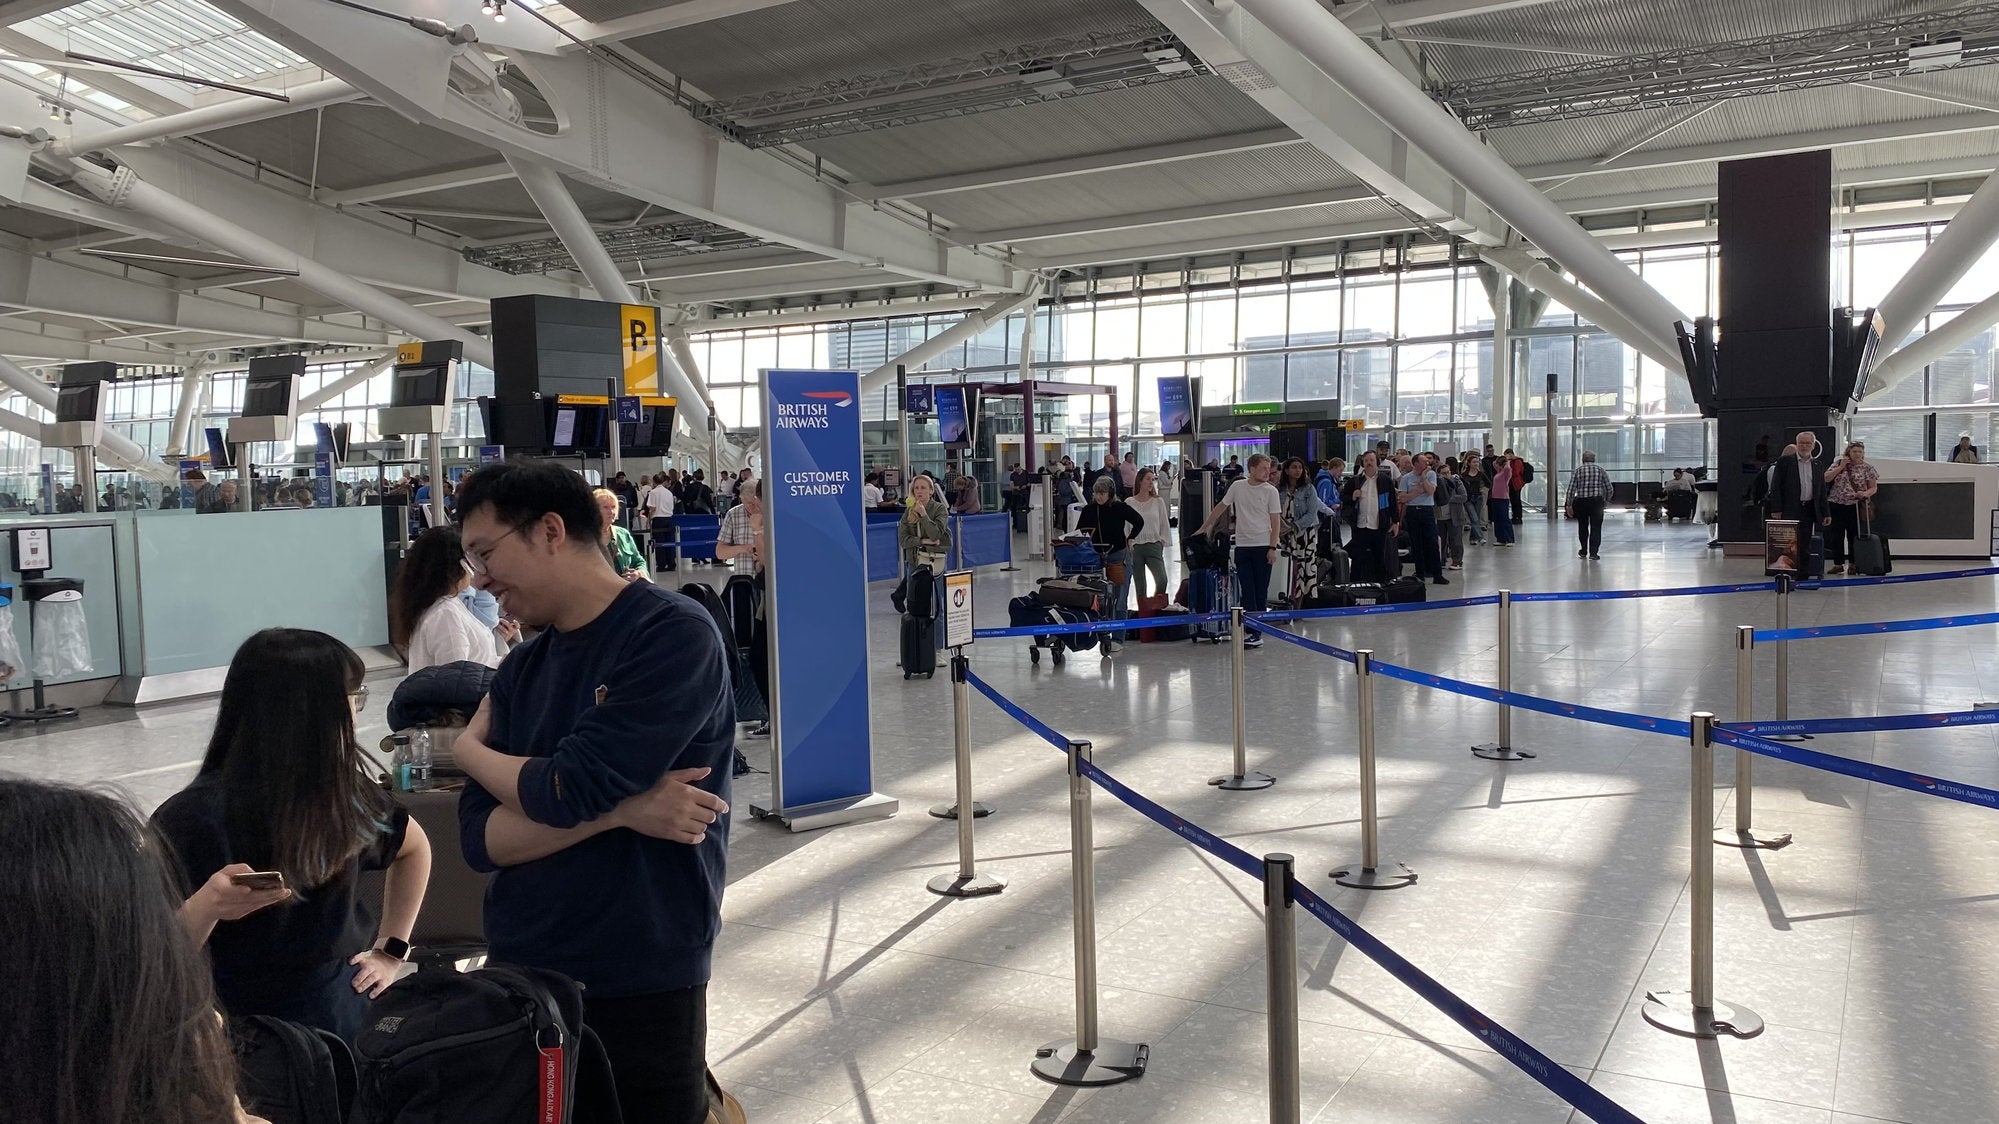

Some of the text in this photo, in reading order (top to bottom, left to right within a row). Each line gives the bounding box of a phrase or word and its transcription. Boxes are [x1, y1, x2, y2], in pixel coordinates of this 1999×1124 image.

[630, 319, 648, 352] B
[778, 403, 827, 416] BRITISH
[775, 416, 829, 429] AIRWAYS
[784, 471, 851, 484] CUSTOMER
[790, 484, 846, 497] STANDBY
[1738, 737, 1782, 754] BRITISH AIRWAYS
[1937, 783, 1996, 802] BRITISH AIRWAYS
[1490, 1030, 1549, 1078] BRITISH AIRWAYS
[546, 1060, 555, 1080] HONG
[546, 1080, 555, 1099] KONG
